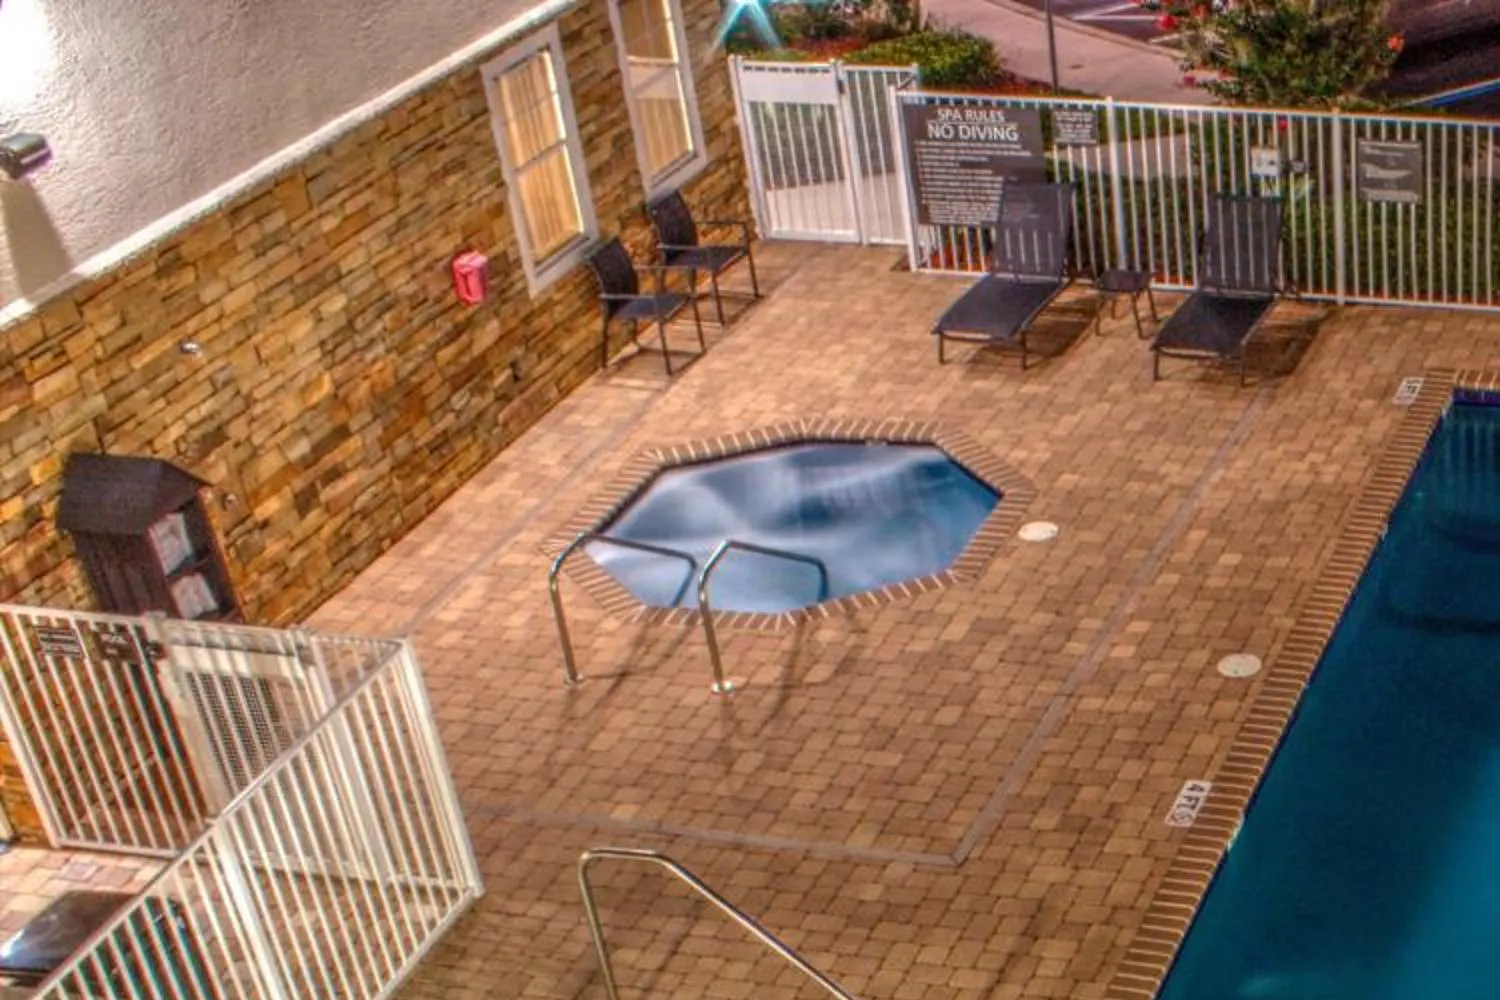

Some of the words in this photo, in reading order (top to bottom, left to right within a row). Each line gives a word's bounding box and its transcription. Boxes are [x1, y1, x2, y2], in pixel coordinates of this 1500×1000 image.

[937, 108, 962, 121] SPA
[965, 109, 1005, 123] RULES
[927, 122, 954, 139] NO
[959, 124, 1019, 141] DIVING
